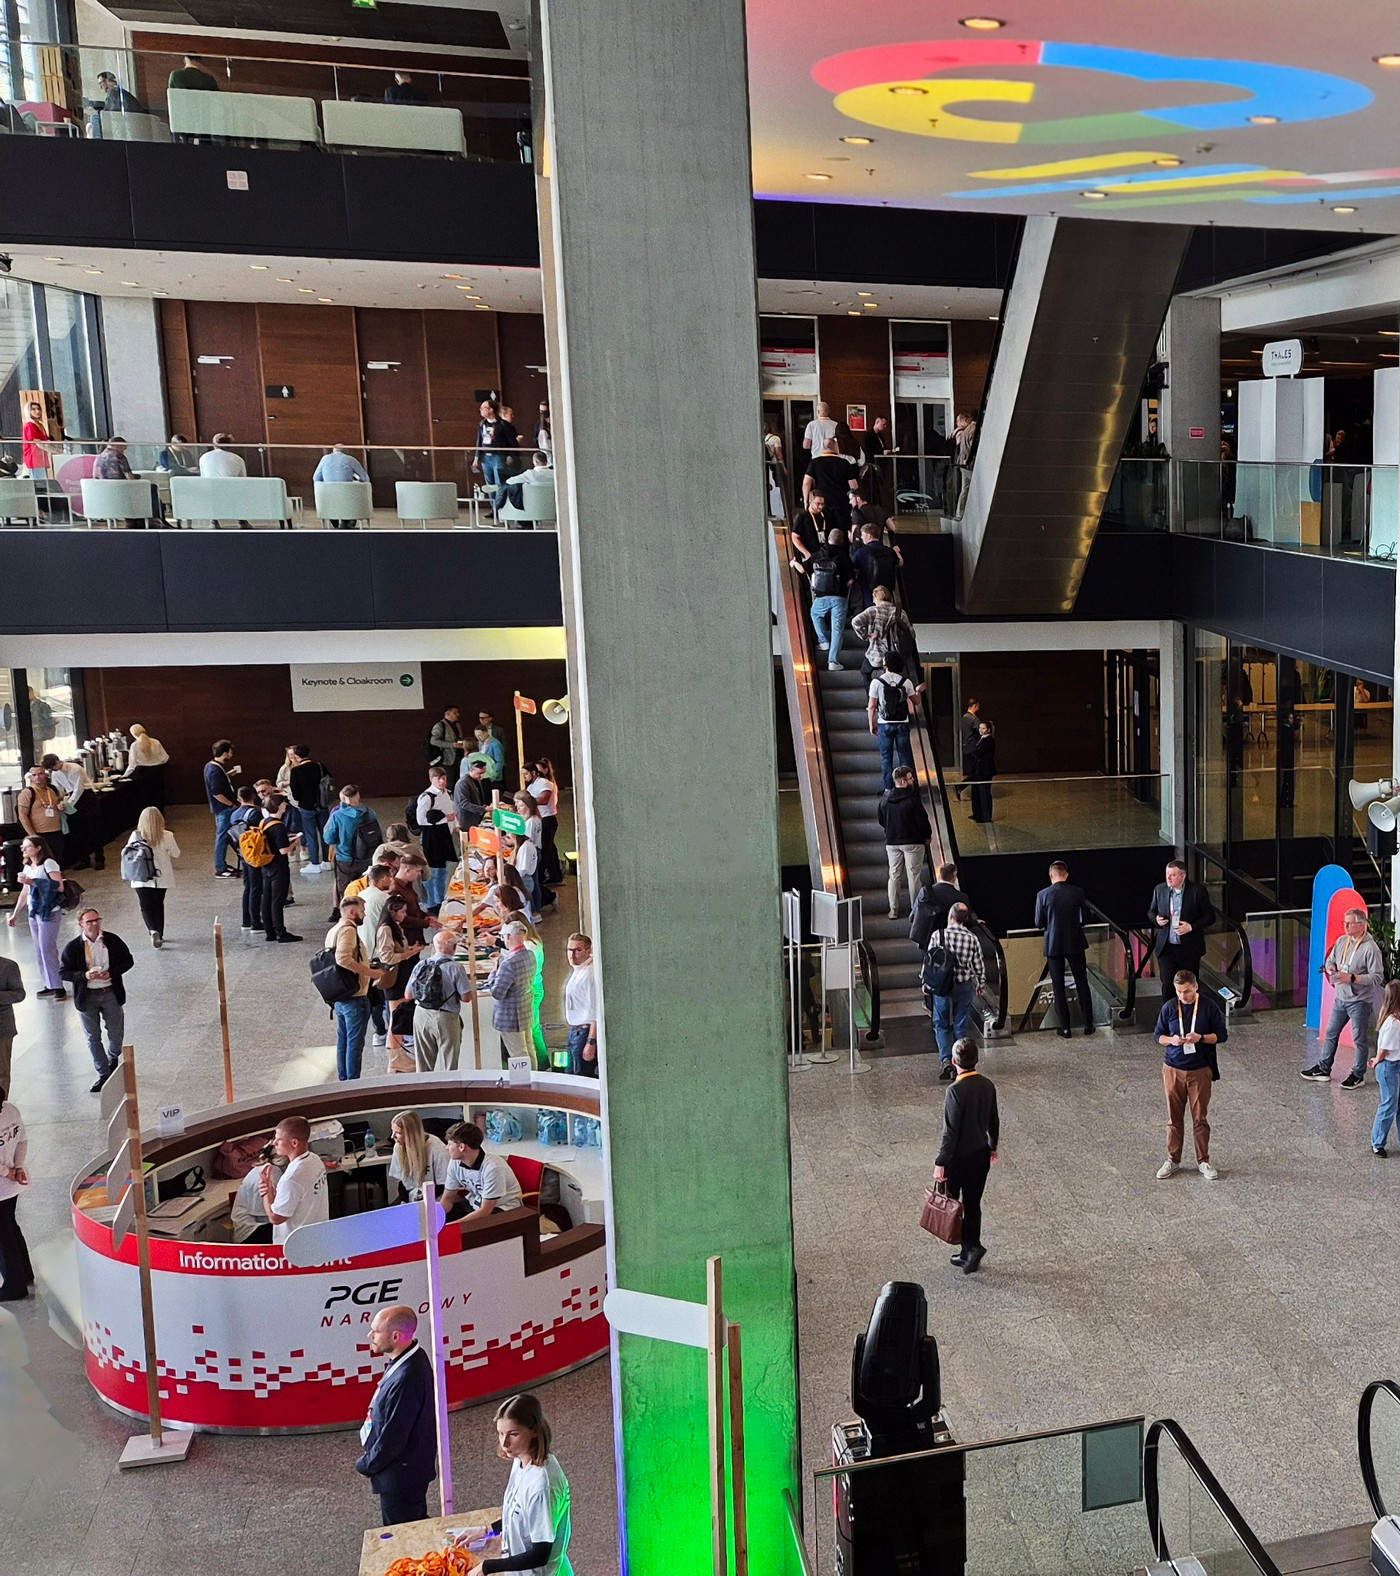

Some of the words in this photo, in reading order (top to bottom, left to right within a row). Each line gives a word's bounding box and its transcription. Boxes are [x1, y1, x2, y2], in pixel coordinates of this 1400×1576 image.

[301, 677, 338, 687] Keynote
[339, 677, 346, 685] &
[346, 676, 394, 685] Cloakroom
[1040, 990, 1056, 999] PG
[511, 1061, 528, 1070] VIP
[162, 1108, 180, 1119] VIP
[179, 1250, 292, 1271] Information
[324, 1278, 403, 1309] PGE
[320, 1292, 472, 1328] NAROWY
